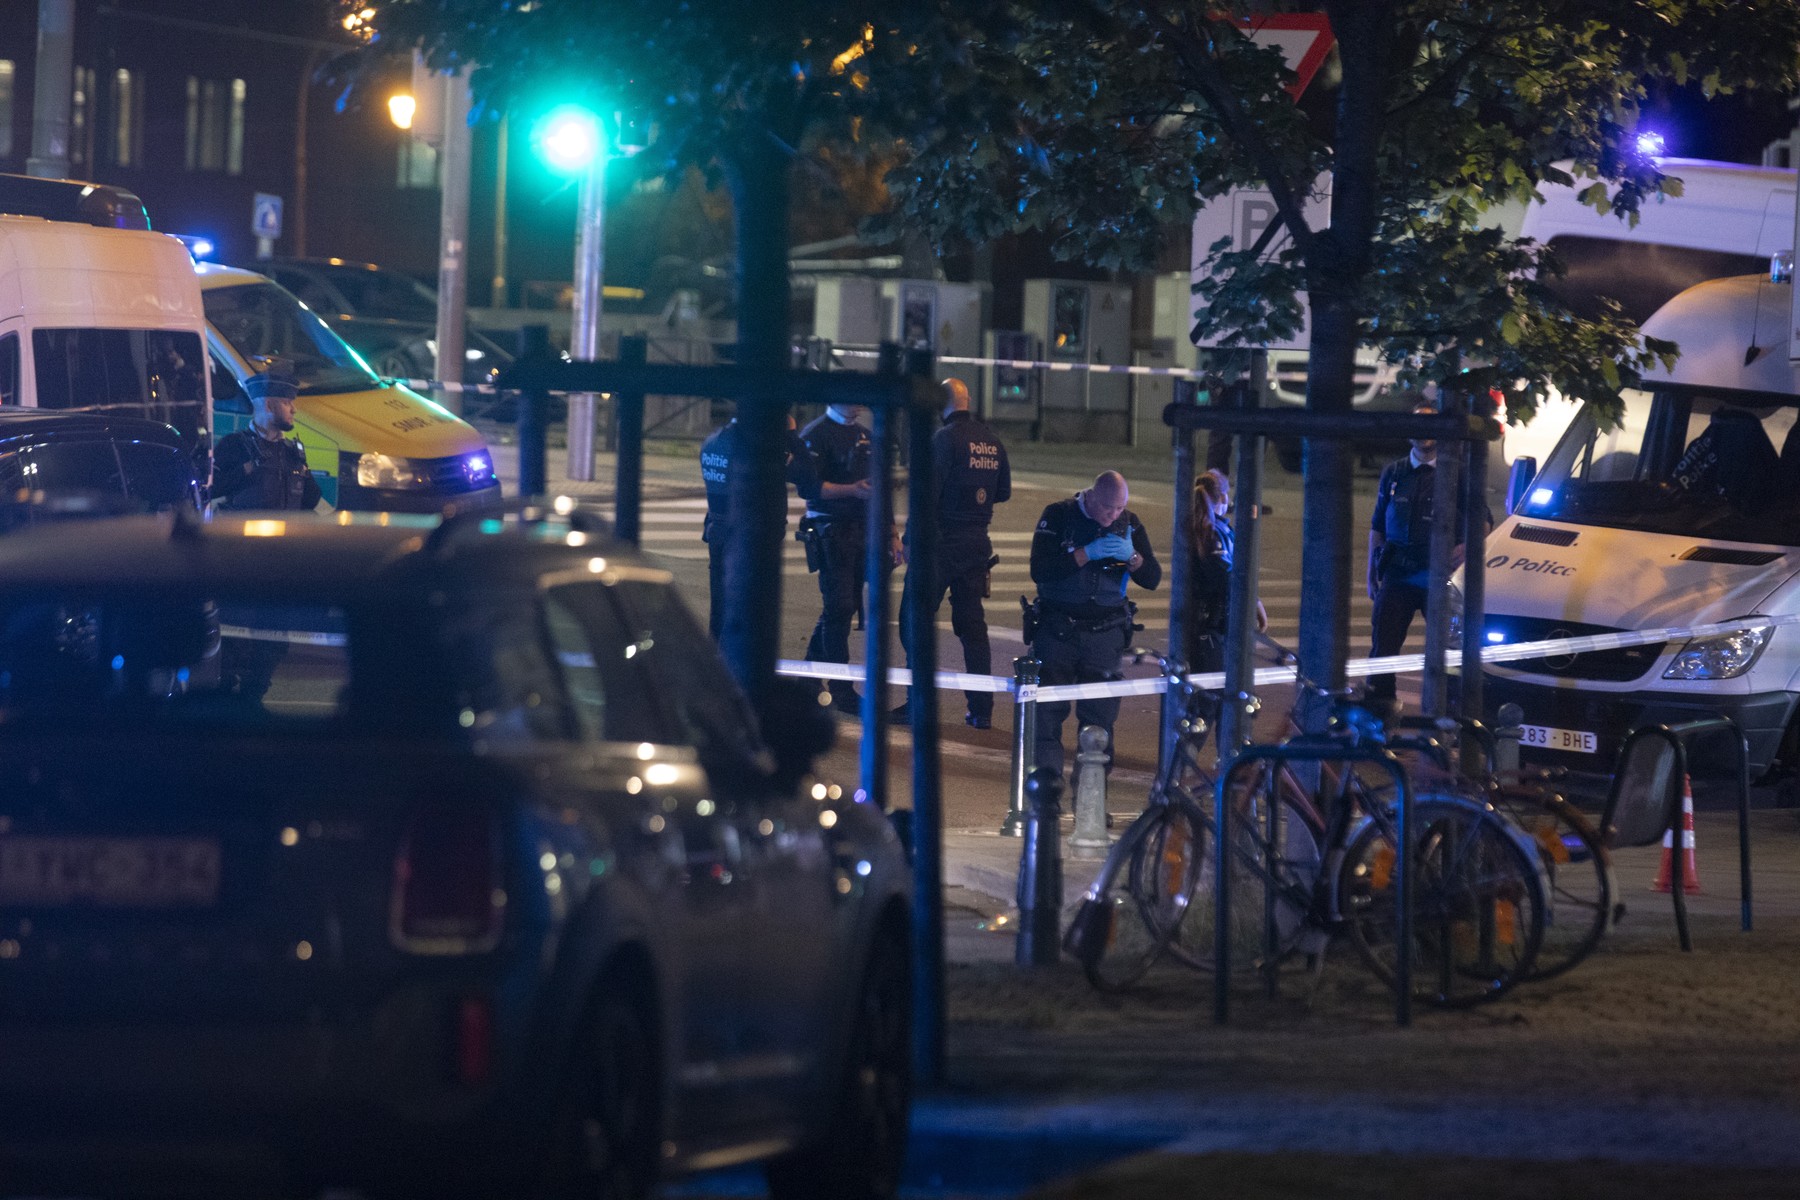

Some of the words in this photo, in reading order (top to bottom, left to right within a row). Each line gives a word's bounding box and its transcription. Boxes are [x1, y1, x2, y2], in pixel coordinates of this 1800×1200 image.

[1241, 200, 1280, 251] P
[969, 442, 998, 455] Police
[701, 452, 729, 468] Politie
[969, 456, 999, 470] Politie
